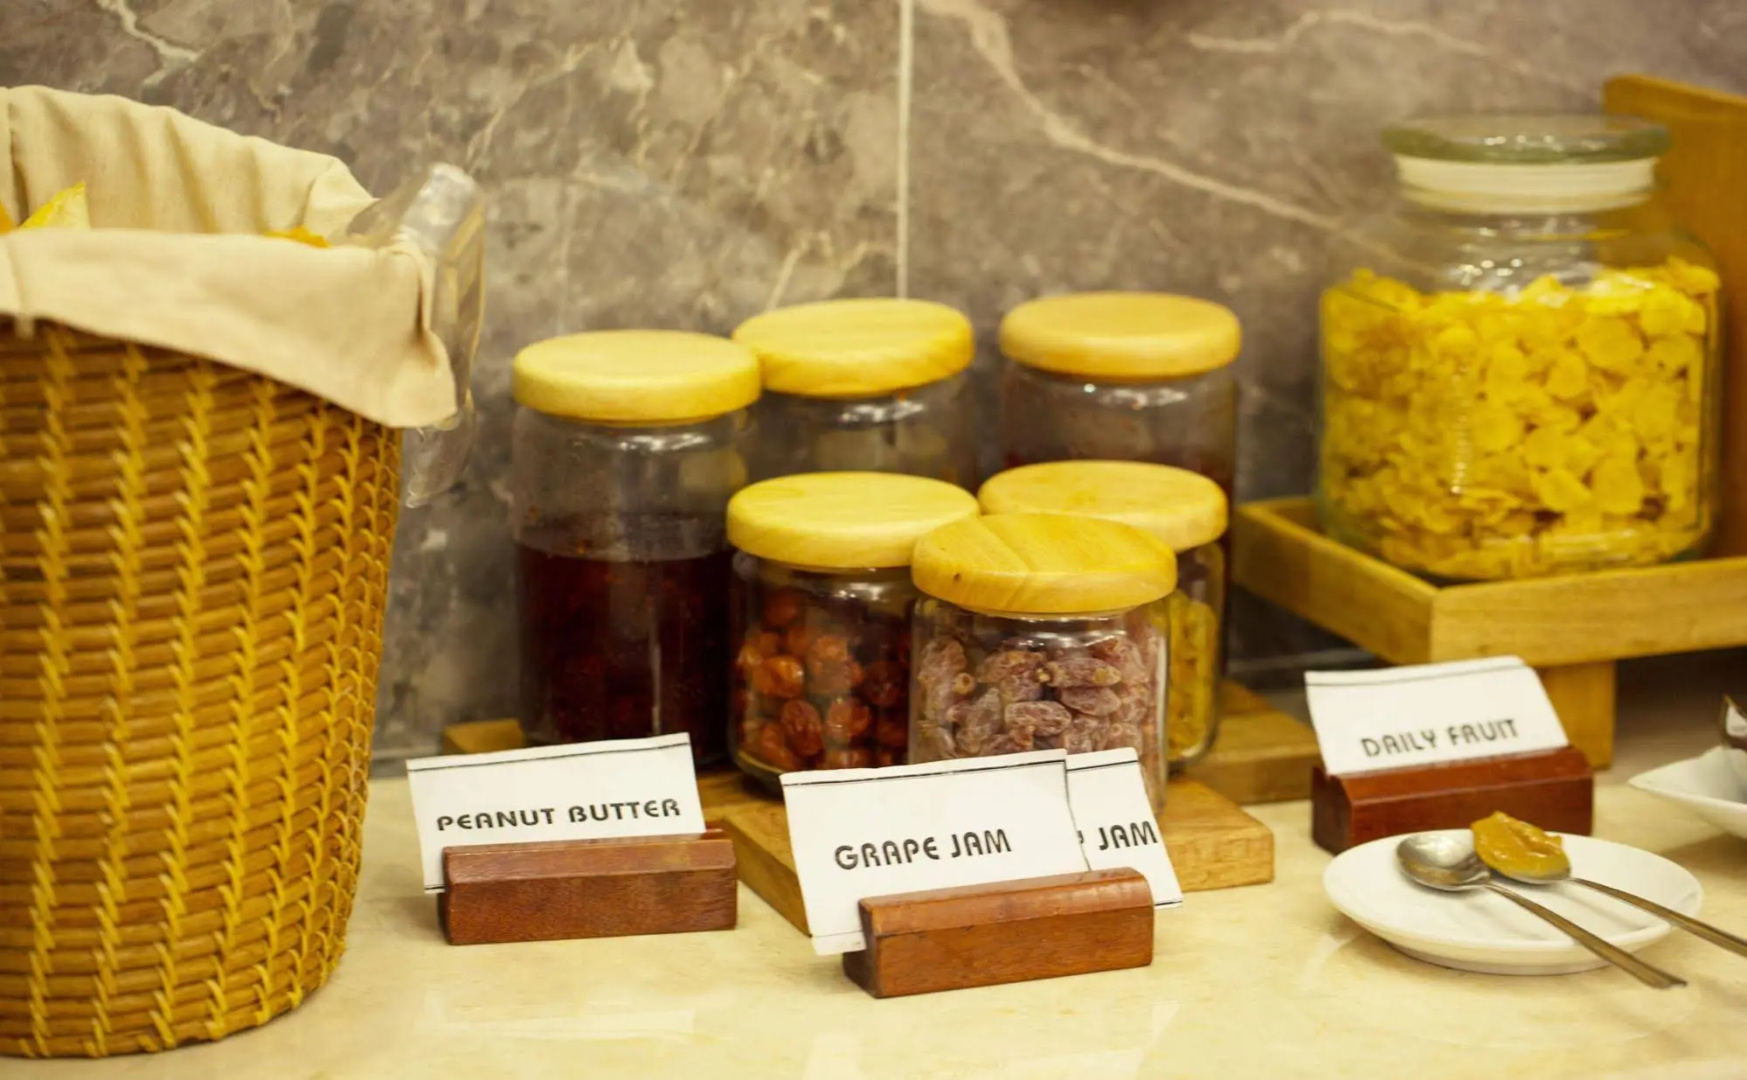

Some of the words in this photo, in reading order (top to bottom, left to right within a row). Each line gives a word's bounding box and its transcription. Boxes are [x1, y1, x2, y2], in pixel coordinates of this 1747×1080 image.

[1360, 728, 1437, 758] DAILY
[1447, 718, 1519, 746] FRUIT
[436, 807, 555, 831] PEANUT
[569, 798, 681, 823] BUTTER
[834, 836, 940, 870] GRAPE
[951, 828, 1012, 858] JAM
[1098, 820, 1159, 851] JAM
